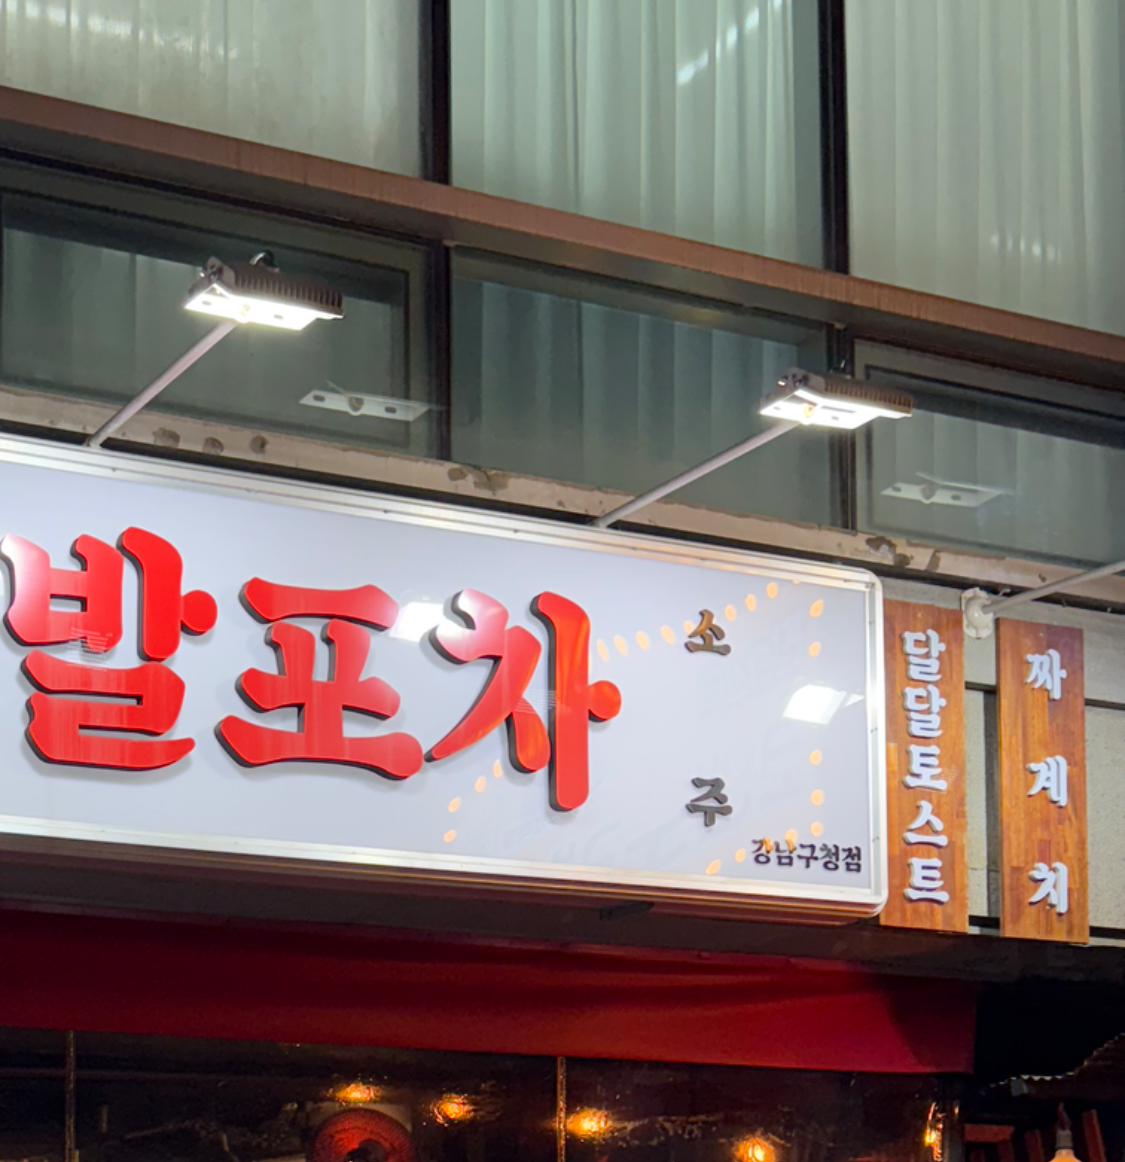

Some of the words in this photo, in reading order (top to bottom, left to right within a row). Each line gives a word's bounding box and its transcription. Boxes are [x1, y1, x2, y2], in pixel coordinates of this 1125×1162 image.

[751, 838, 863, 873] 강남구청점
[902, 629, 949, 905] 달달토스트
[1025, 648, 1069, 915] 짜계치
